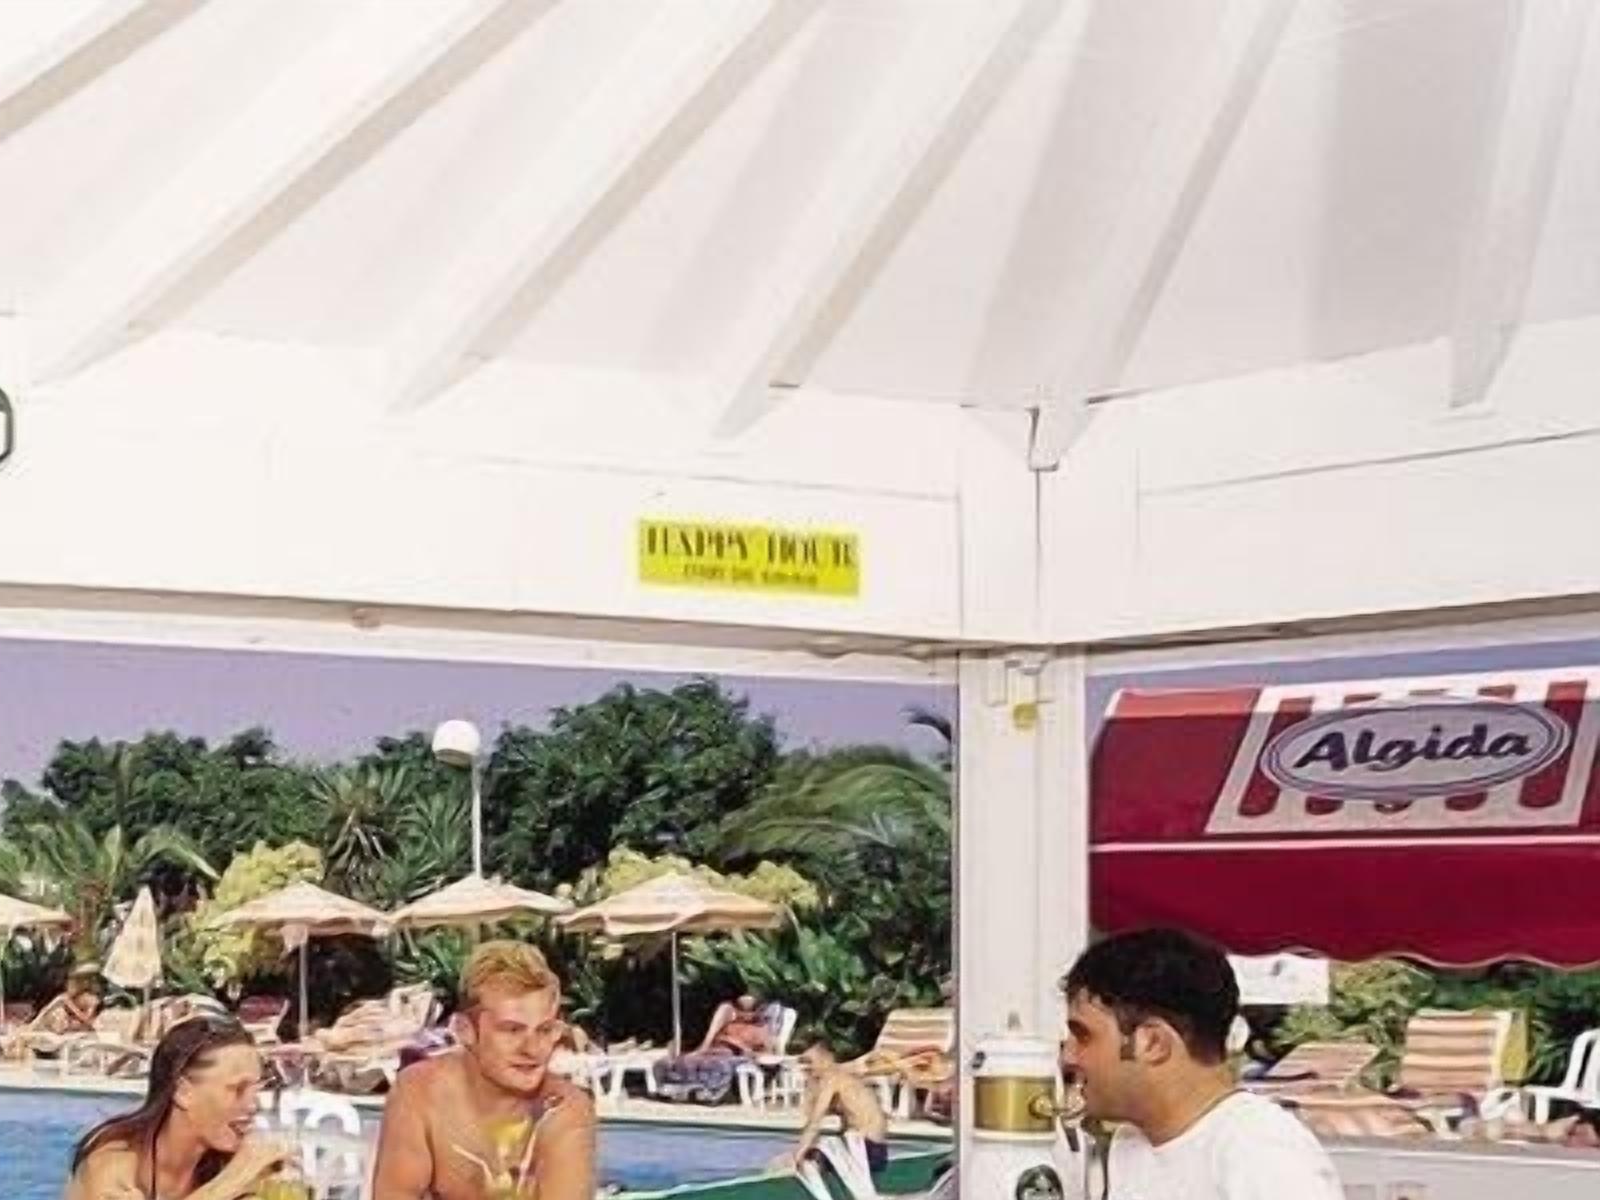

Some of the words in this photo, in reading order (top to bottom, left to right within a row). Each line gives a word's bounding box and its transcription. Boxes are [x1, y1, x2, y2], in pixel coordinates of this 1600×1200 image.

[647, 526, 748, 561] HAPPY
[767, 532, 852, 567] HOUR
[1293, 723, 1533, 773] Algida
